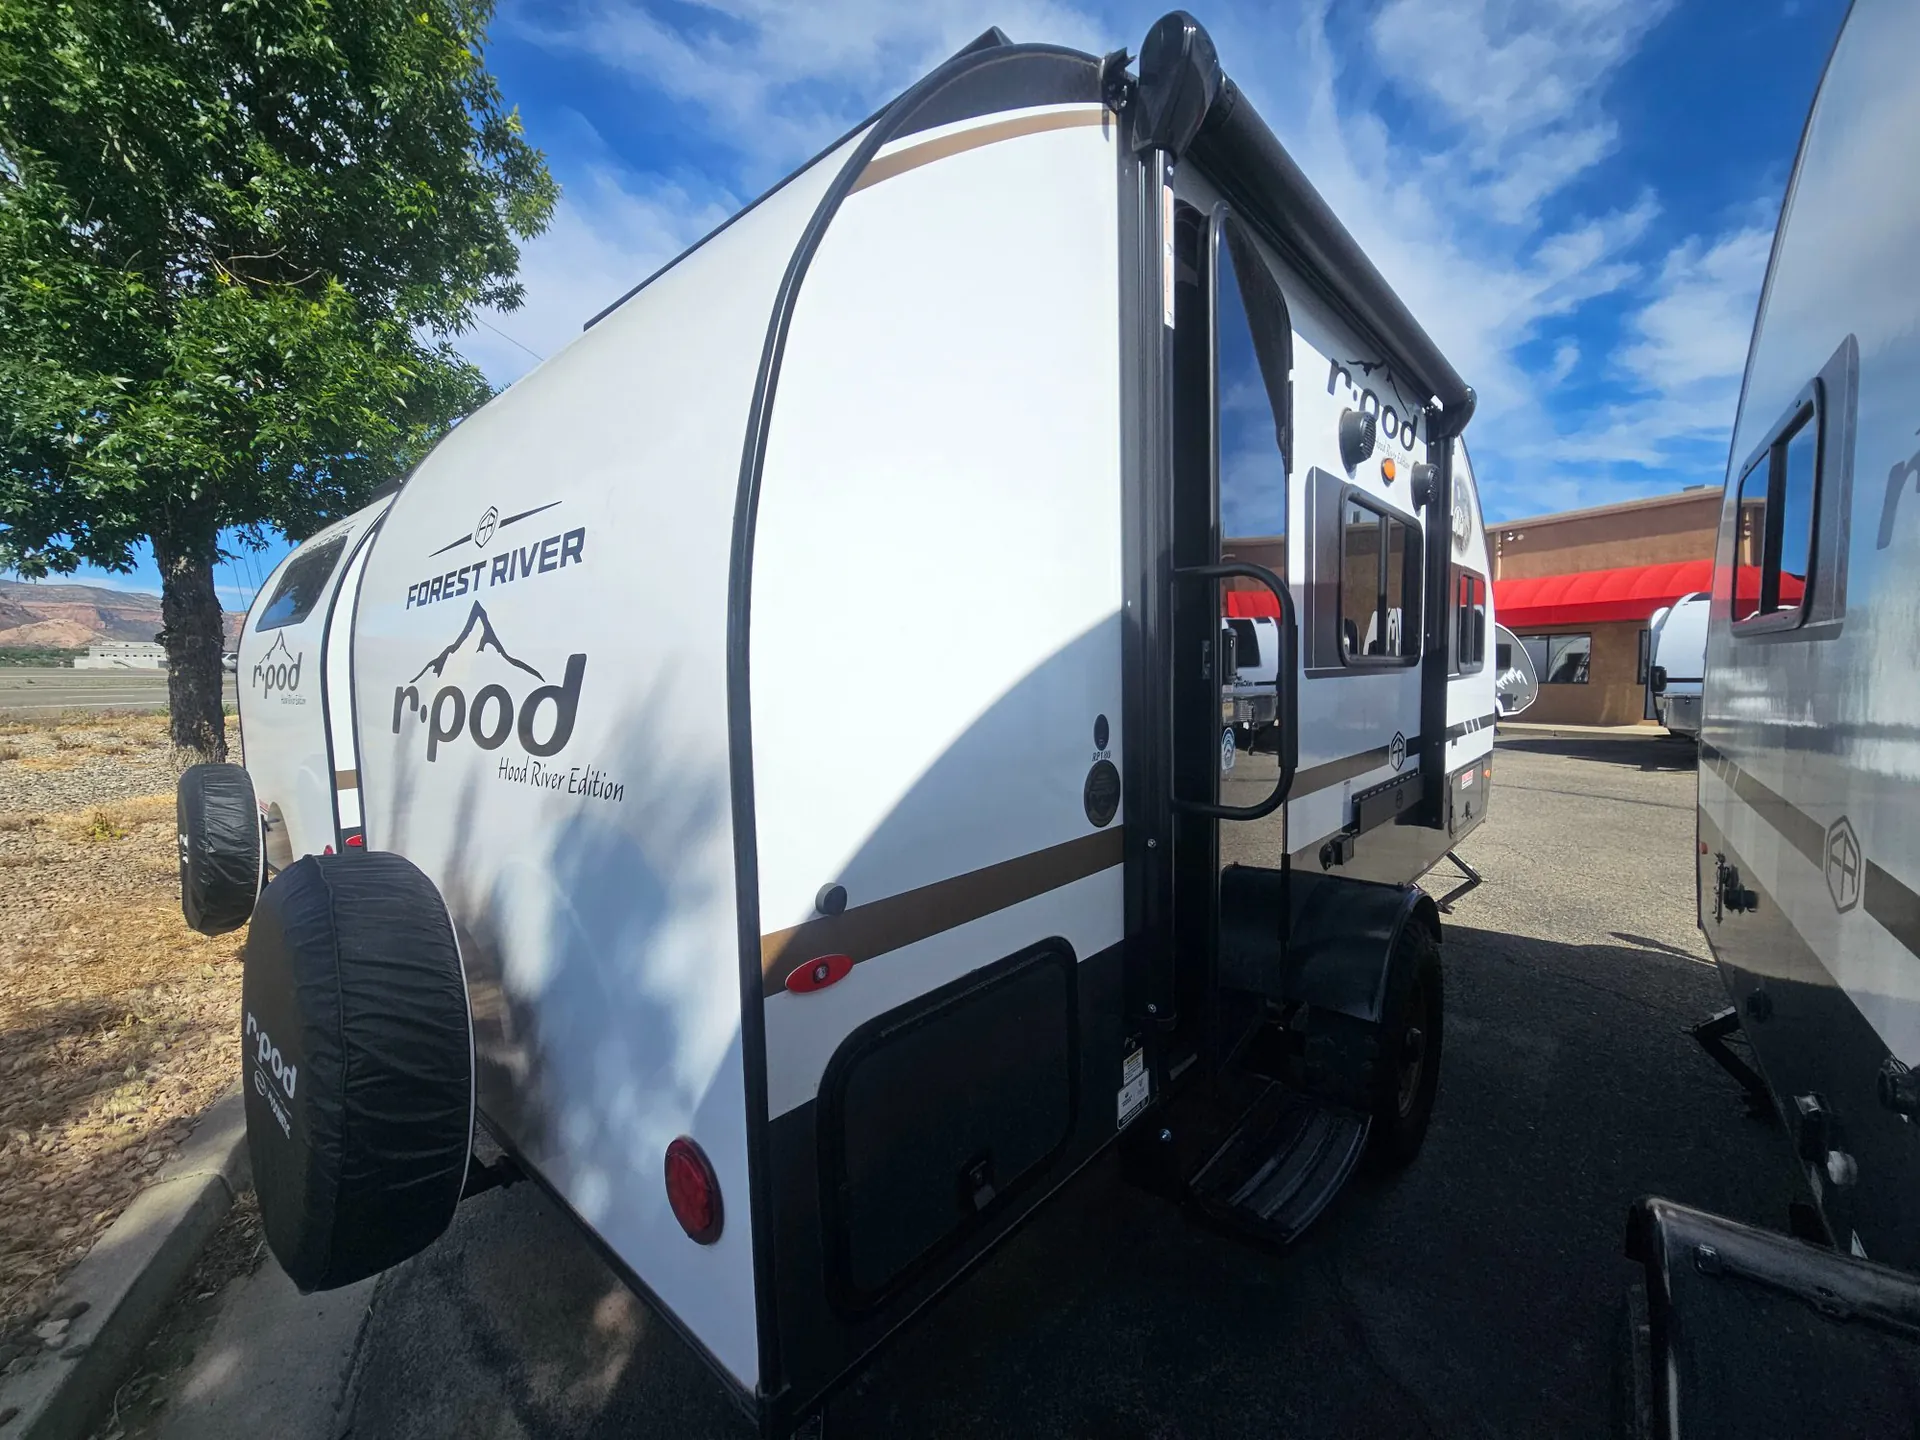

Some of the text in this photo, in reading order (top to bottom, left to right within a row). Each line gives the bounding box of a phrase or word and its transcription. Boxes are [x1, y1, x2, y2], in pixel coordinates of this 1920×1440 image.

[406, 527, 586, 610] FOREST RIVER
[499, 756, 624, 802] Hood River Edition
